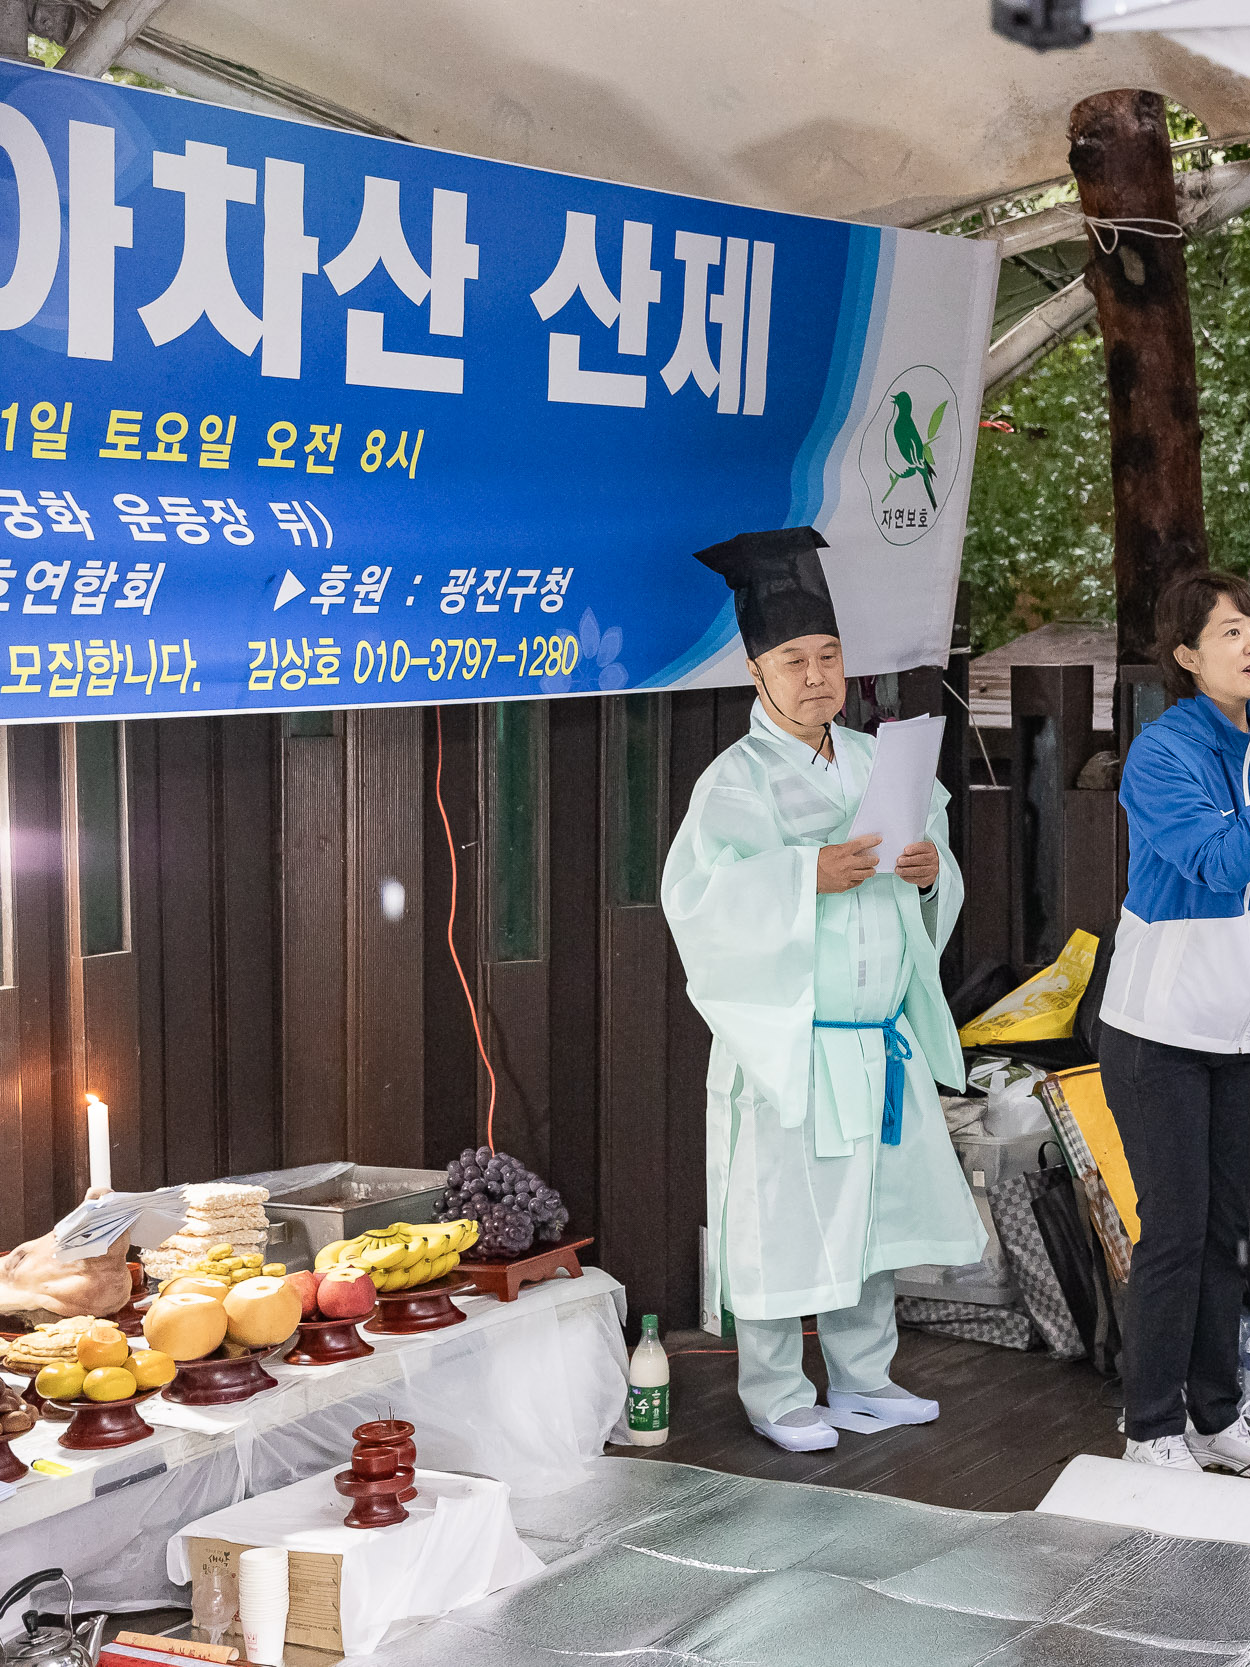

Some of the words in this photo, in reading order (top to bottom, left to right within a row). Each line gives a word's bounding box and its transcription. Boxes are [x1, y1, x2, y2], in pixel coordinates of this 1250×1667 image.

[0, 103, 479, 394] 아차산
[530, 210, 775, 415] 산제
[99, 409, 237, 469] 토요일
[257, 420, 342, 475] 오전
[360, 428, 425, 479] 8시
[0, 488, 95, 541] 궁화
[112, 493, 256, 546] 운동장
[268, 500, 335, 549] 뒤)
[881, 507, 929, 529] 자연보호
[310, 564, 393, 615] 후원
[405, 574, 423, 606] :
[440, 567, 574, 613] 광진구청
[1, 638, 201, 698] 모집합니다.
[247, 637, 342, 691] 김상호
[353, 635, 579, 684] 010-3797-1280
